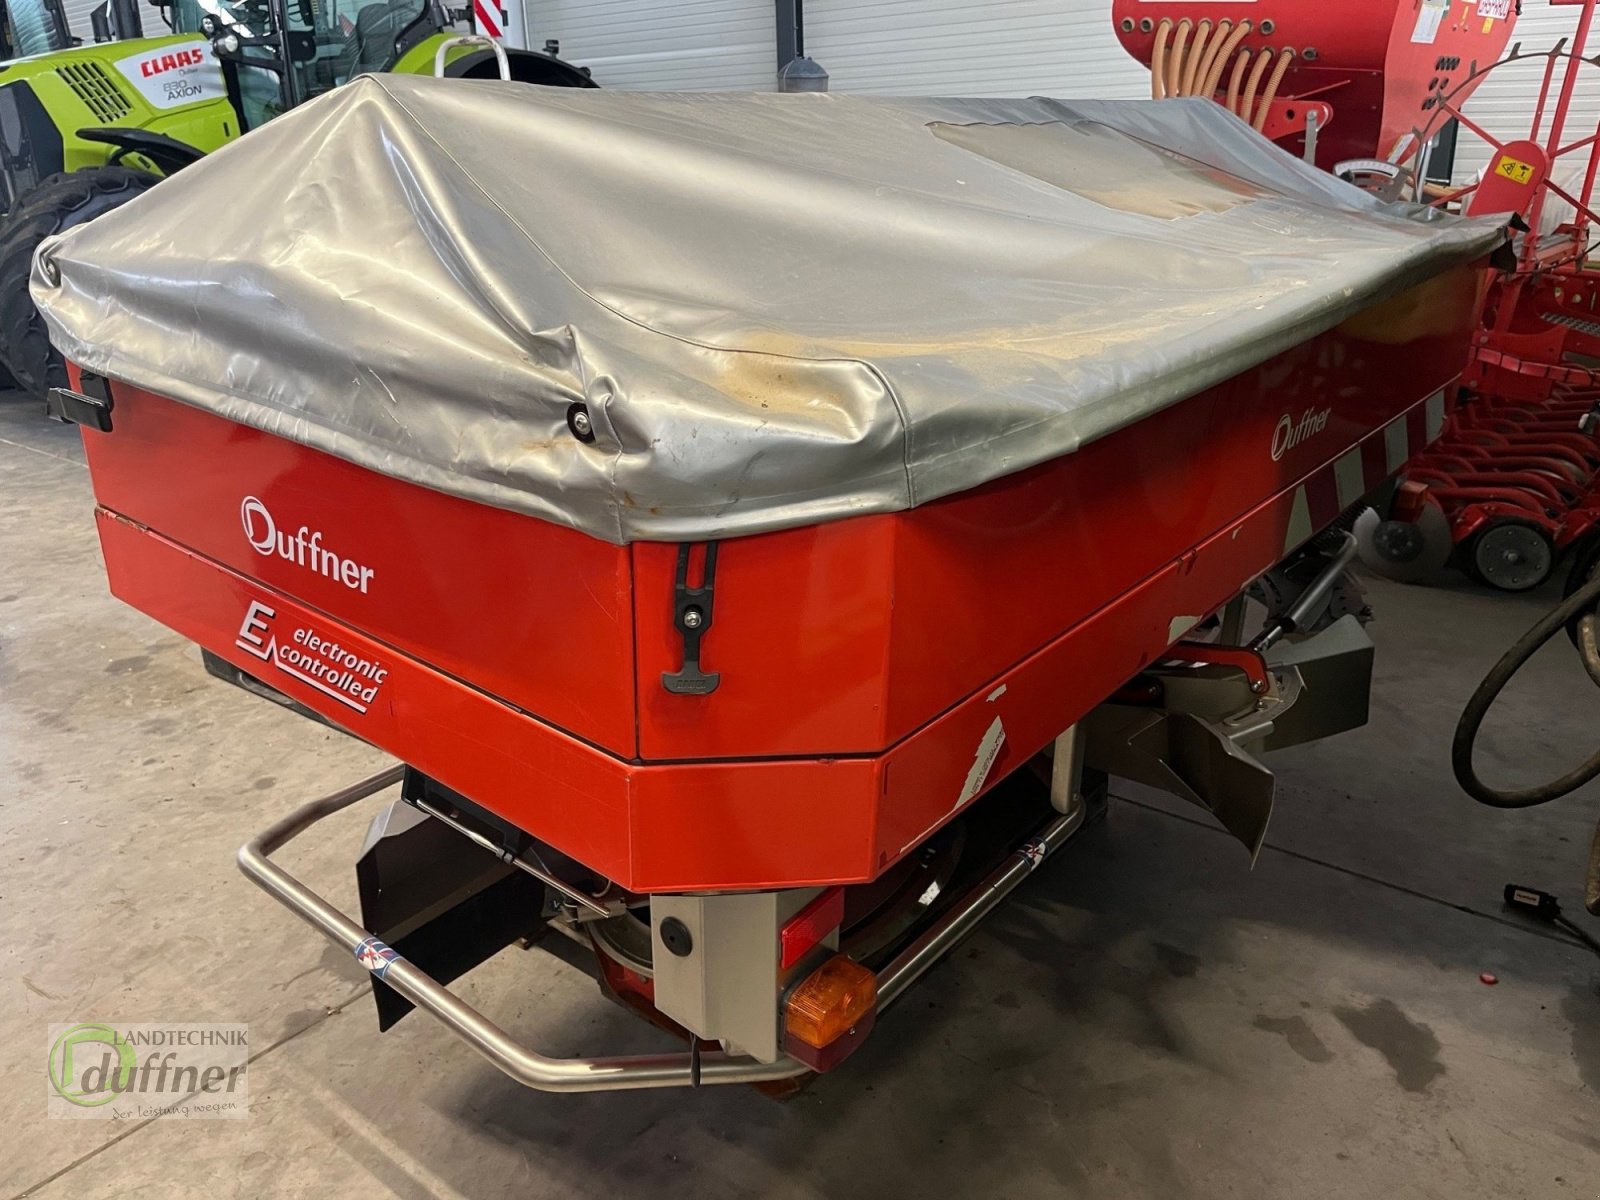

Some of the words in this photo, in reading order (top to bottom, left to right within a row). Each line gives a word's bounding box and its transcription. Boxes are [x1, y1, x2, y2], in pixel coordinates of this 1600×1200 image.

[140, 48, 203, 77] CLAAS
[163, 80, 187, 92] 830
[167, 85, 202, 100] AXION
[1271, 406, 1332, 462] Duffner
[241, 495, 374, 594] Duffner
[279, 645, 379, 704] controlled
[293, 628, 388, 684] electronic
